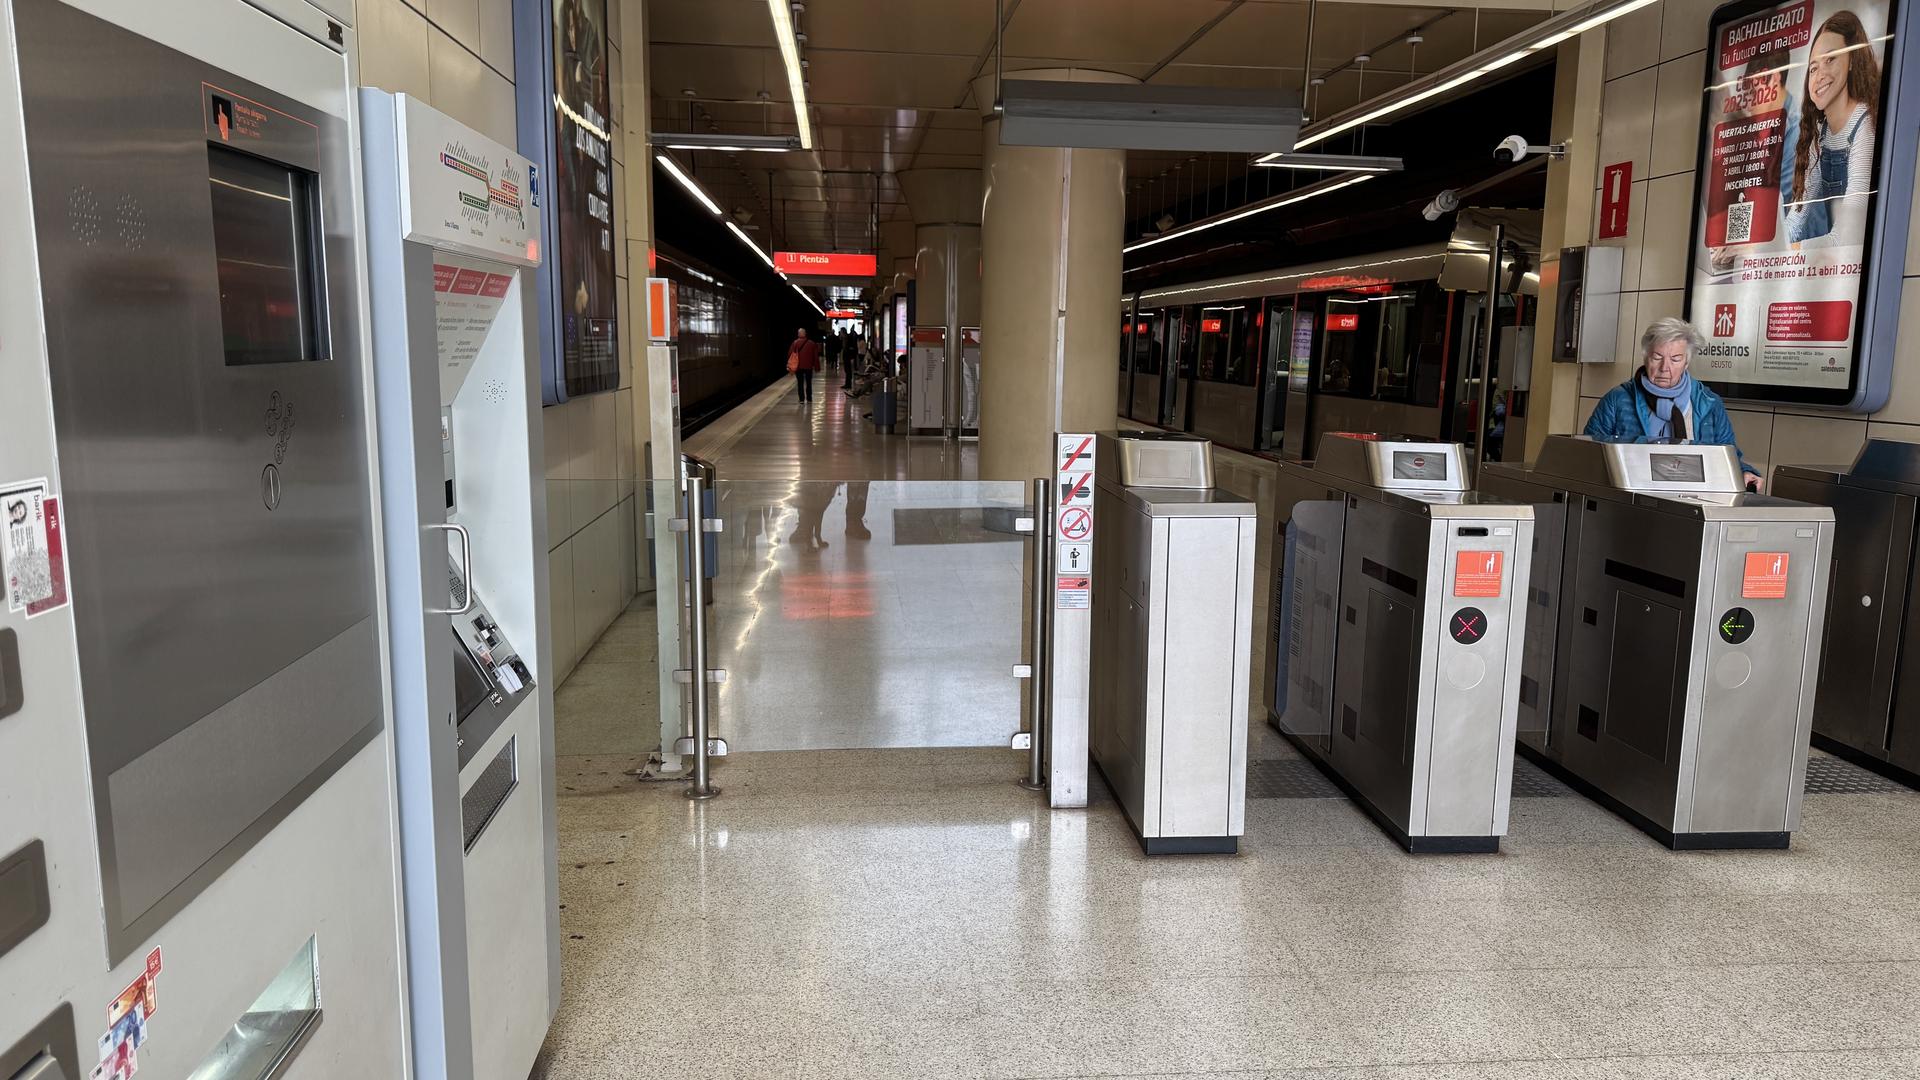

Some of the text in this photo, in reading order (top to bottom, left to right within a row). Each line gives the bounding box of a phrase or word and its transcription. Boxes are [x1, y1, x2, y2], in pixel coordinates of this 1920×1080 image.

[1728, 6, 1805, 46] BACHILLERATO
[1722, 29, 1809, 66] Tu futuro en marcha
[1723, 85, 1778, 113] 2025-2026
[1718, 117, 1782, 140] PUERTAS ABIERTAS:
[1720, 144, 1735, 155] MARZO
[1763, 135, 1777, 146] 18:30
[1728, 154, 1745, 164] MARZO
[1749, 150, 1764, 160] 18:00
[1727, 165, 1742, 176] ABRIL
[1745, 162, 1760, 173] 18:00
[1724, 176, 1763, 191] INSCRÍBETE:
[799, 254, 830, 264] Plentzia
[1743, 252, 1807, 269] PREINSCRIPCIÓN
[1742, 263, 1862, 281] del 31 de marzo al 11 abril 2025
[1711, 360, 1732, 369] DEUSTO
[34, 494, 42, 521] barik
